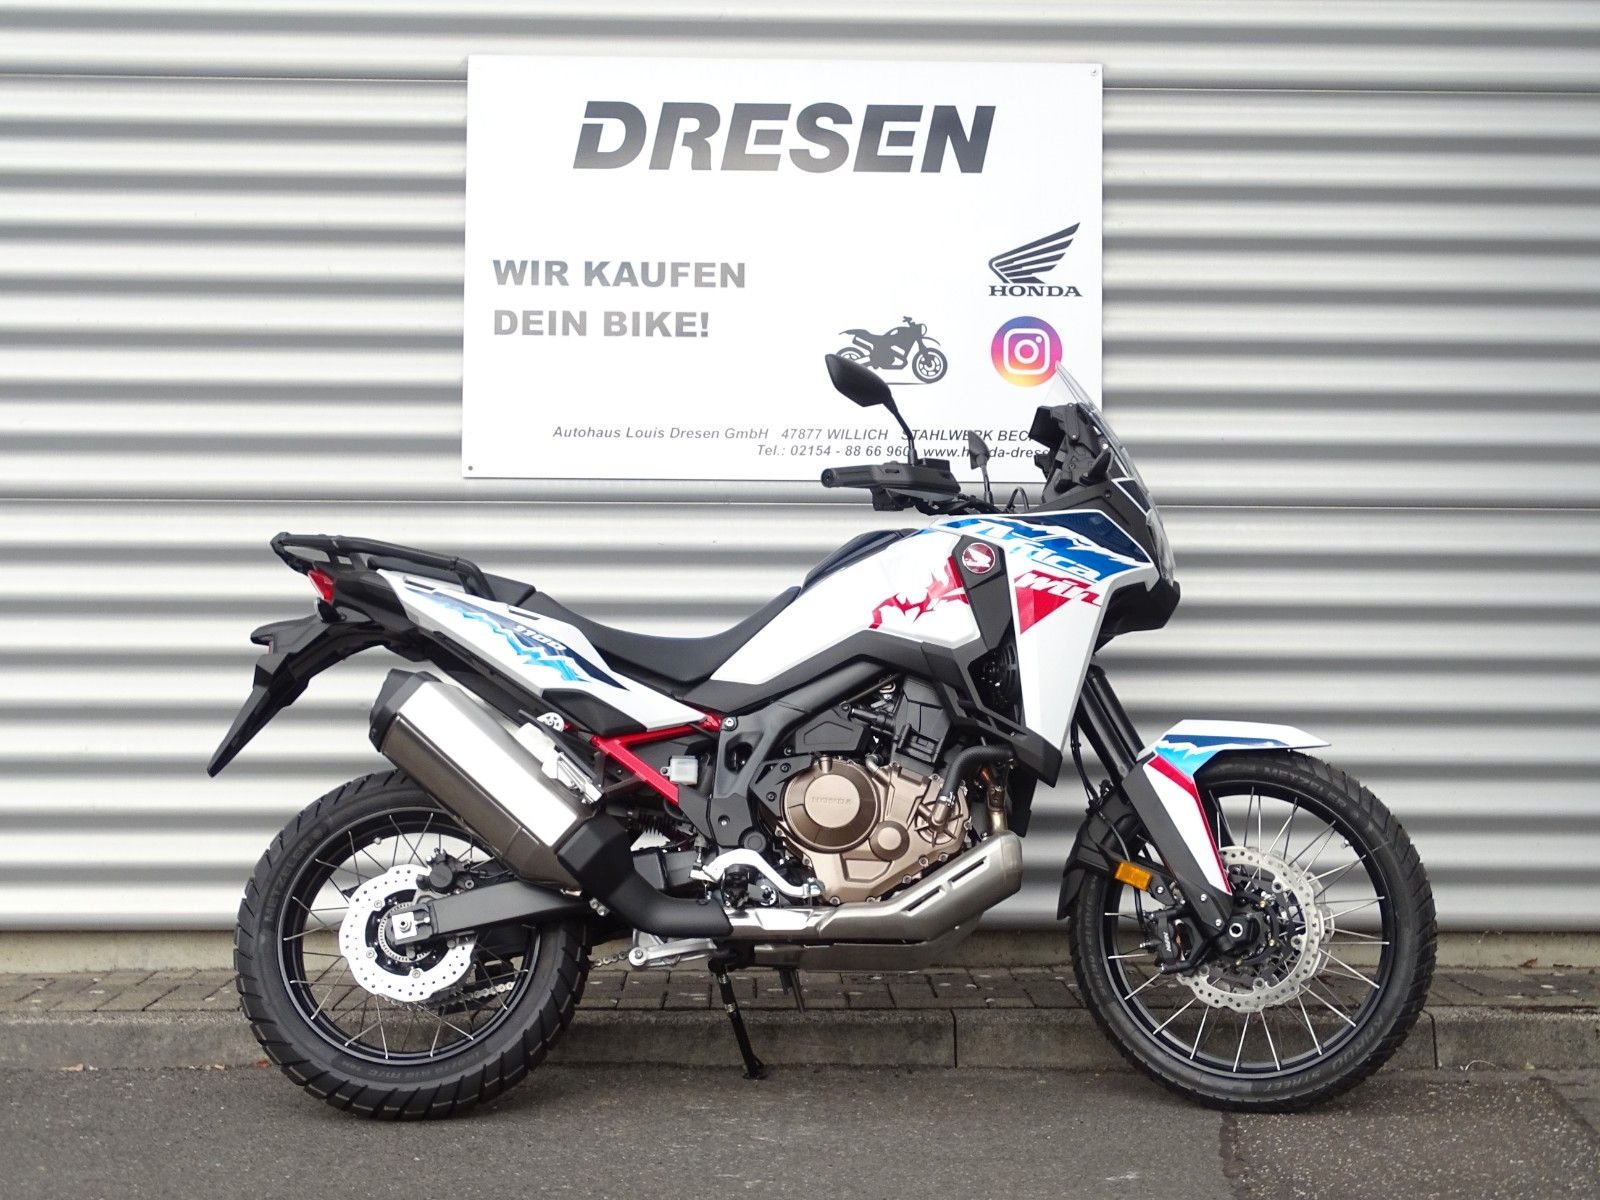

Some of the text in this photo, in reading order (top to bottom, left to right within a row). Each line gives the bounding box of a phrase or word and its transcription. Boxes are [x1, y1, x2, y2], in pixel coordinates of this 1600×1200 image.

[573, 100, 996, 174] DRESEN
[493, 259, 746, 288] WIR KAUFEN
[989, 285, 1083, 298] HONDA
[493, 310, 709, 338] DEIN BIKE!
[552, 425, 622, 439] Autohaus
[626, 426, 665, 439] Louis
[669, 427, 720, 440] Dresen
[724, 427, 769, 440] GmbH
[781, 428, 823, 441] 47877
[827, 428, 889, 441] WILLICH
[757, 444, 786, 456] Tel.:
[790, 444, 832, 457] 02154
[844, 445, 862, 457] 88
[865, 445, 883, 457] 66
